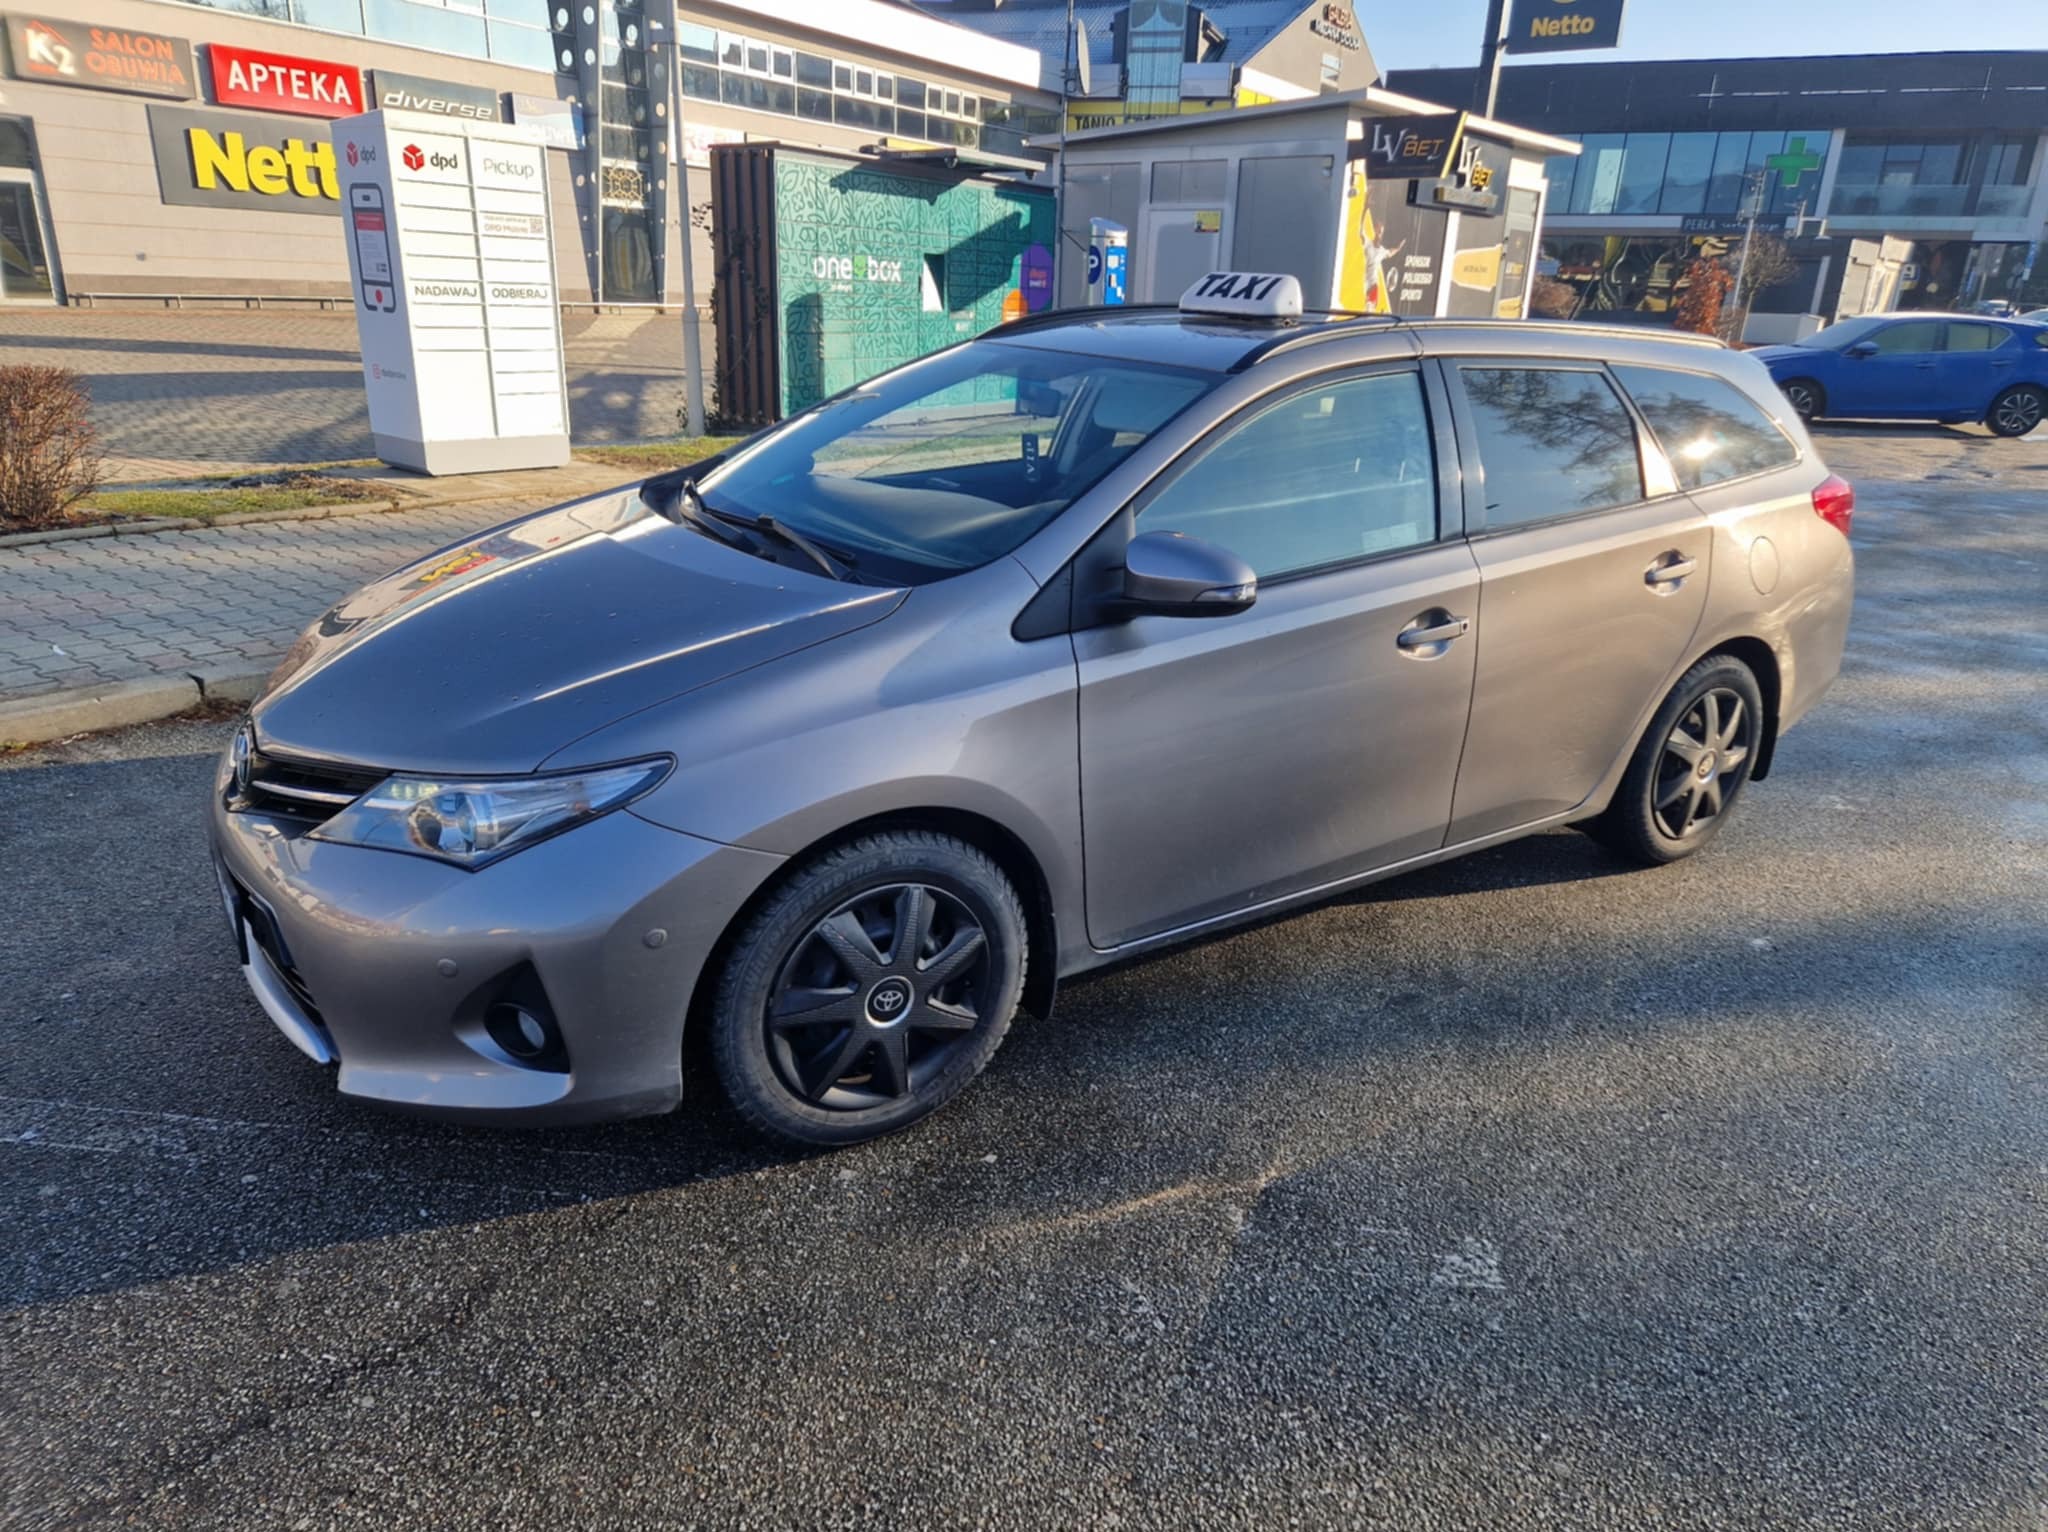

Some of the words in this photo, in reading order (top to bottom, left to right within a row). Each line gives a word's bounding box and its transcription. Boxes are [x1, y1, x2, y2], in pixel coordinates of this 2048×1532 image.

[1530, 14, 1595, 38] Netto
[89, 27, 174, 62] SALON
[85, 51, 187, 85] OBUWIA
[228, 59, 353, 105] APTEKA
[383, 89, 493, 120] diverse
[188, 127, 342, 200] Nett
[360, 145, 377, 165] dpd
[430, 151, 459, 171] dpd
[483, 158, 535, 178] Pickup
[414, 285, 478, 298] NADAWAJ
[491, 286, 548, 299] ODBIERAJ
[1195, 274, 1283, 301] TAXI
